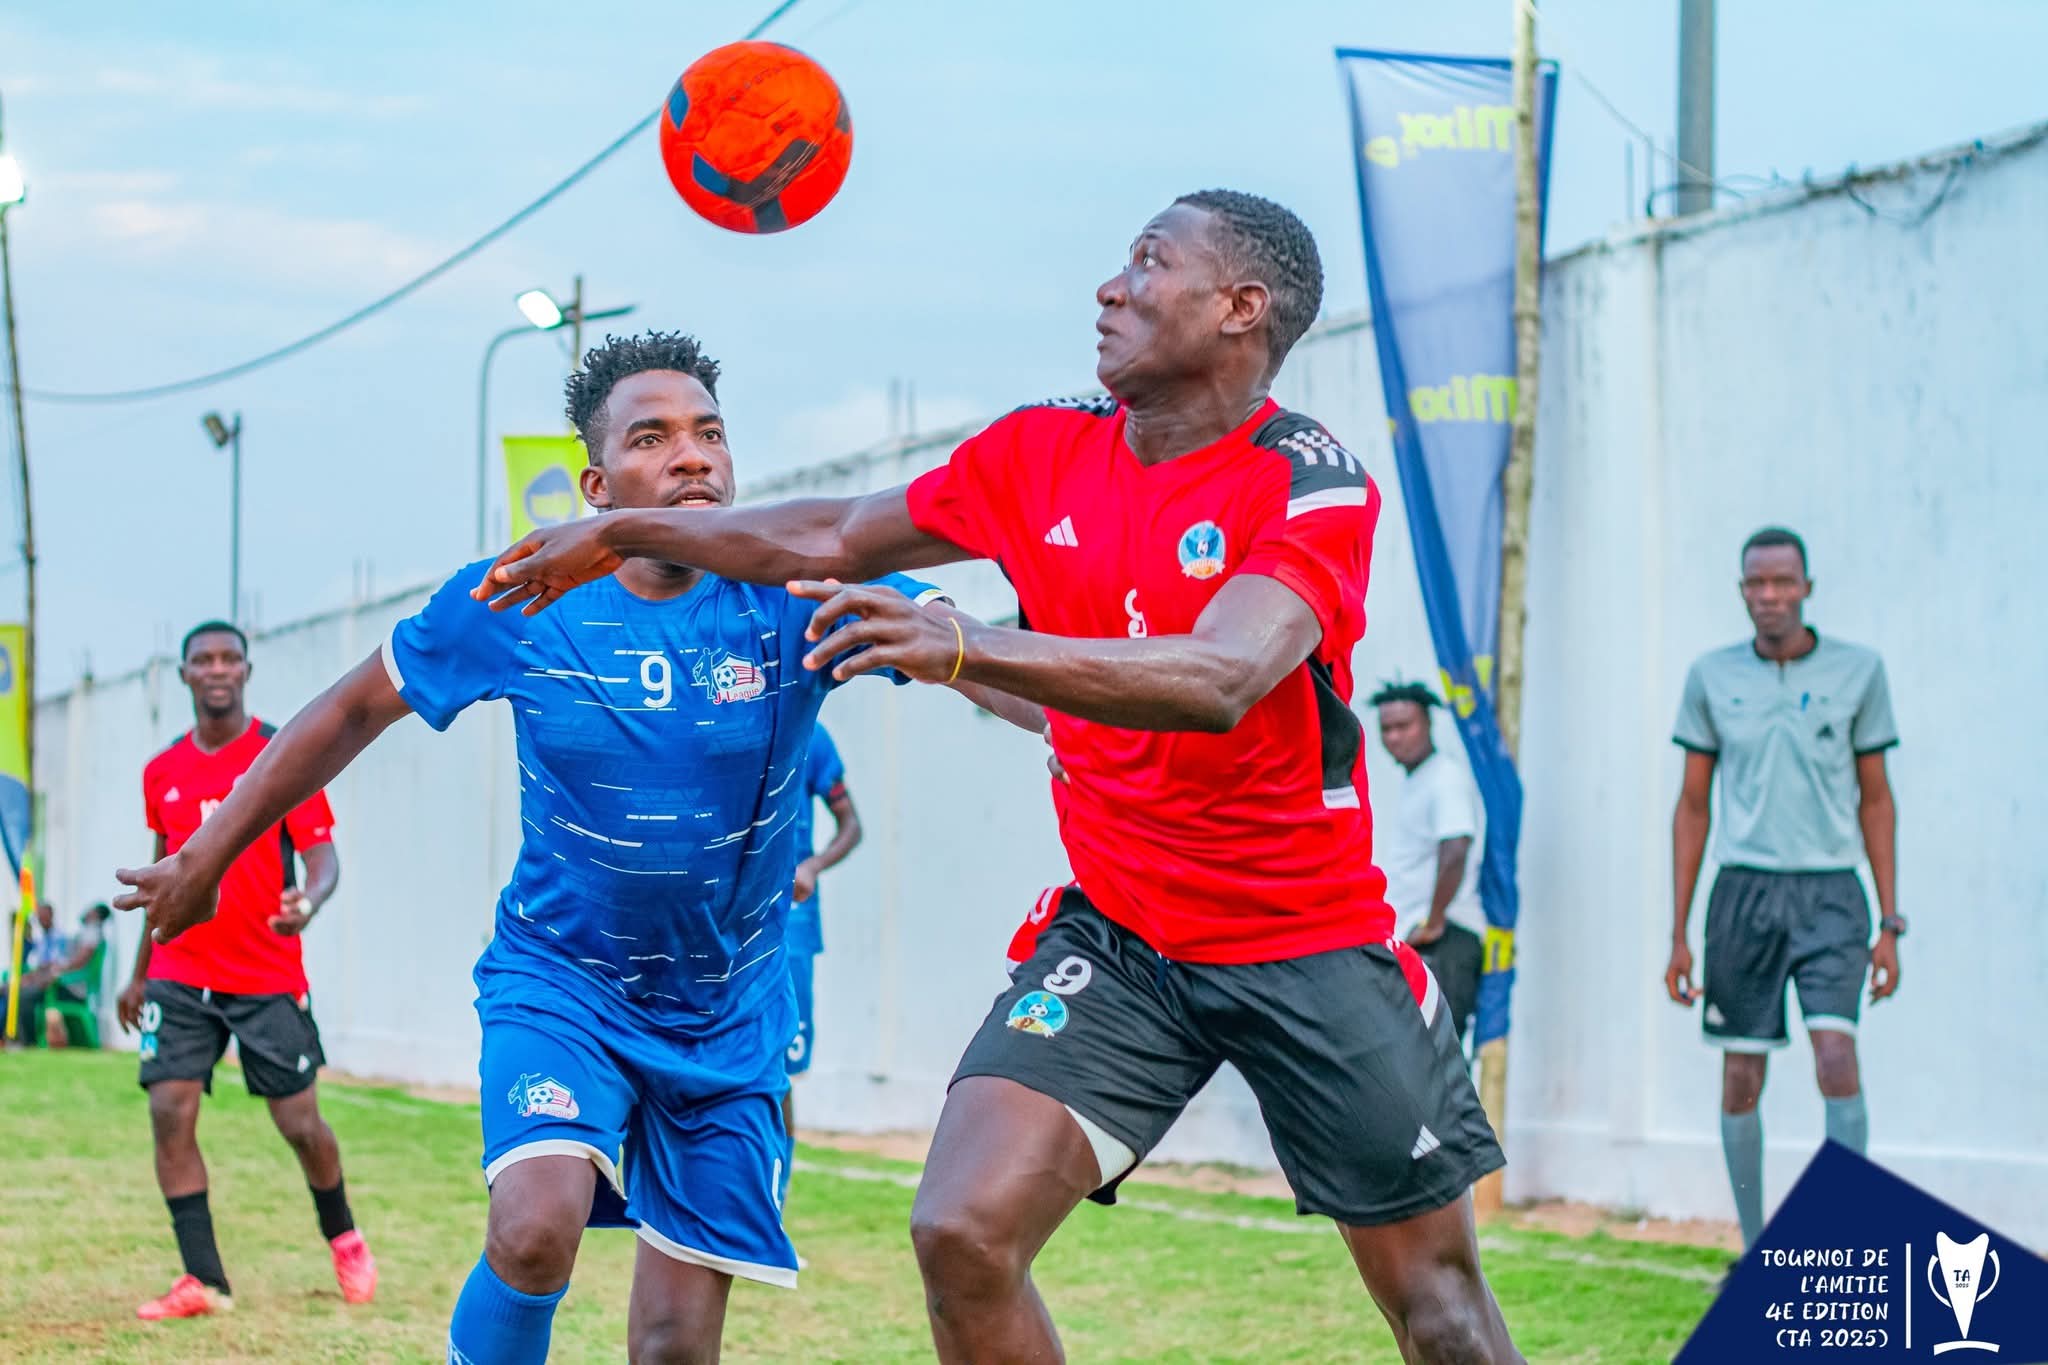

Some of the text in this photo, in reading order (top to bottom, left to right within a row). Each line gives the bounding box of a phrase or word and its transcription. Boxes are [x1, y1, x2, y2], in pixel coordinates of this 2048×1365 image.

[640, 655, 672, 708] 9
[713, 687, 760, 704] J League
[1043, 955, 1092, 995] 9
